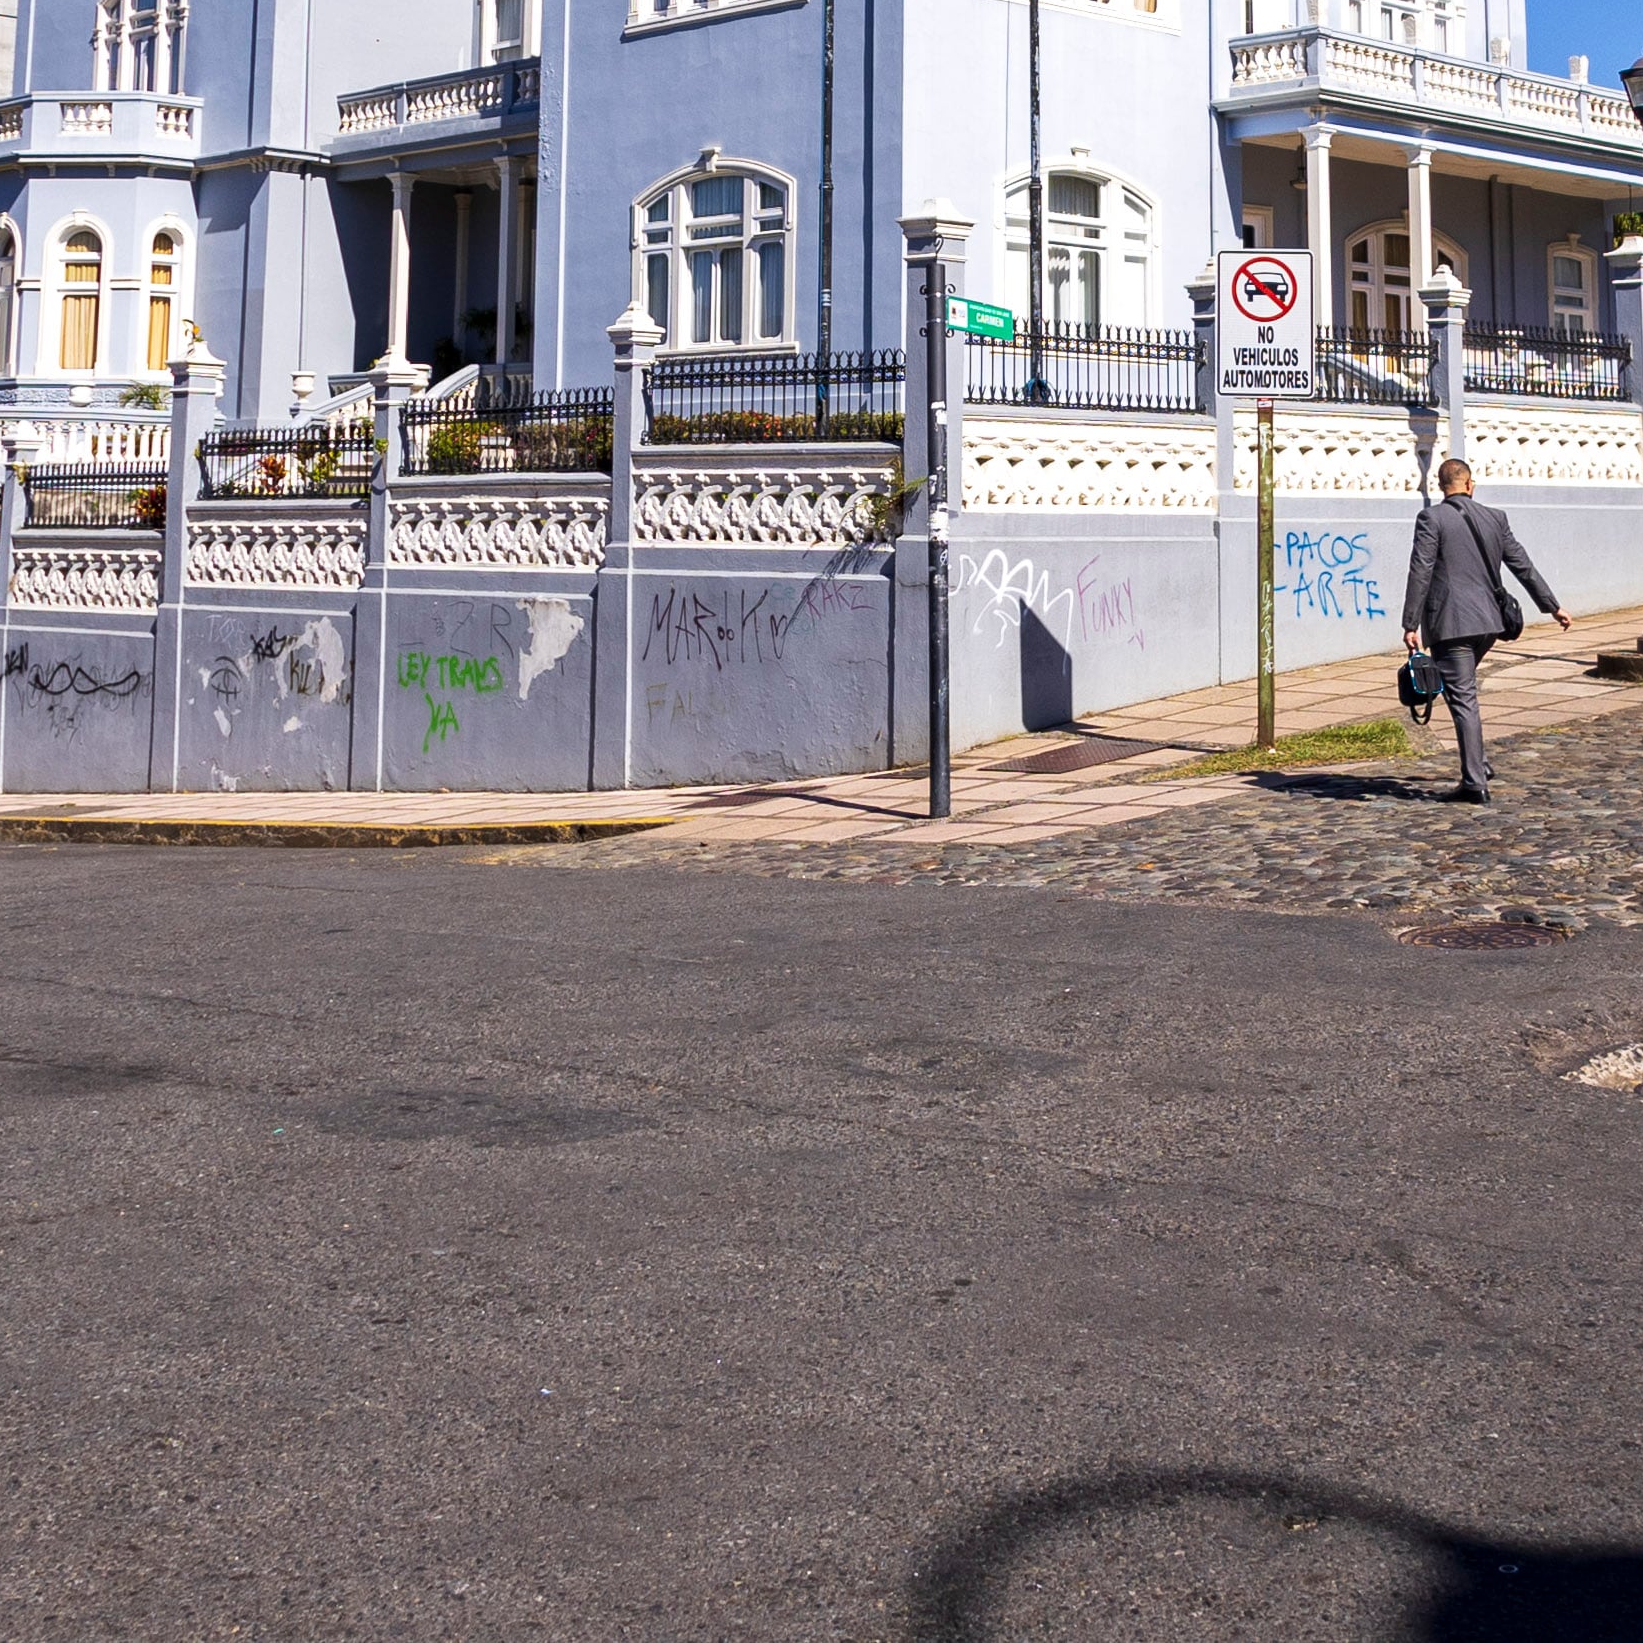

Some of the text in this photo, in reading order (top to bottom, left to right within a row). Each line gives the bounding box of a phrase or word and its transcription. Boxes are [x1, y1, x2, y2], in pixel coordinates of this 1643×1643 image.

[1257, 326, 1274, 344] NO
[1233, 348, 1299, 366] VEHICULOS
[1223, 370, 1308, 389] AUTOMOTORES
[397, 651, 430, 689] LEY
[436, 655, 503, 693] TRANS
